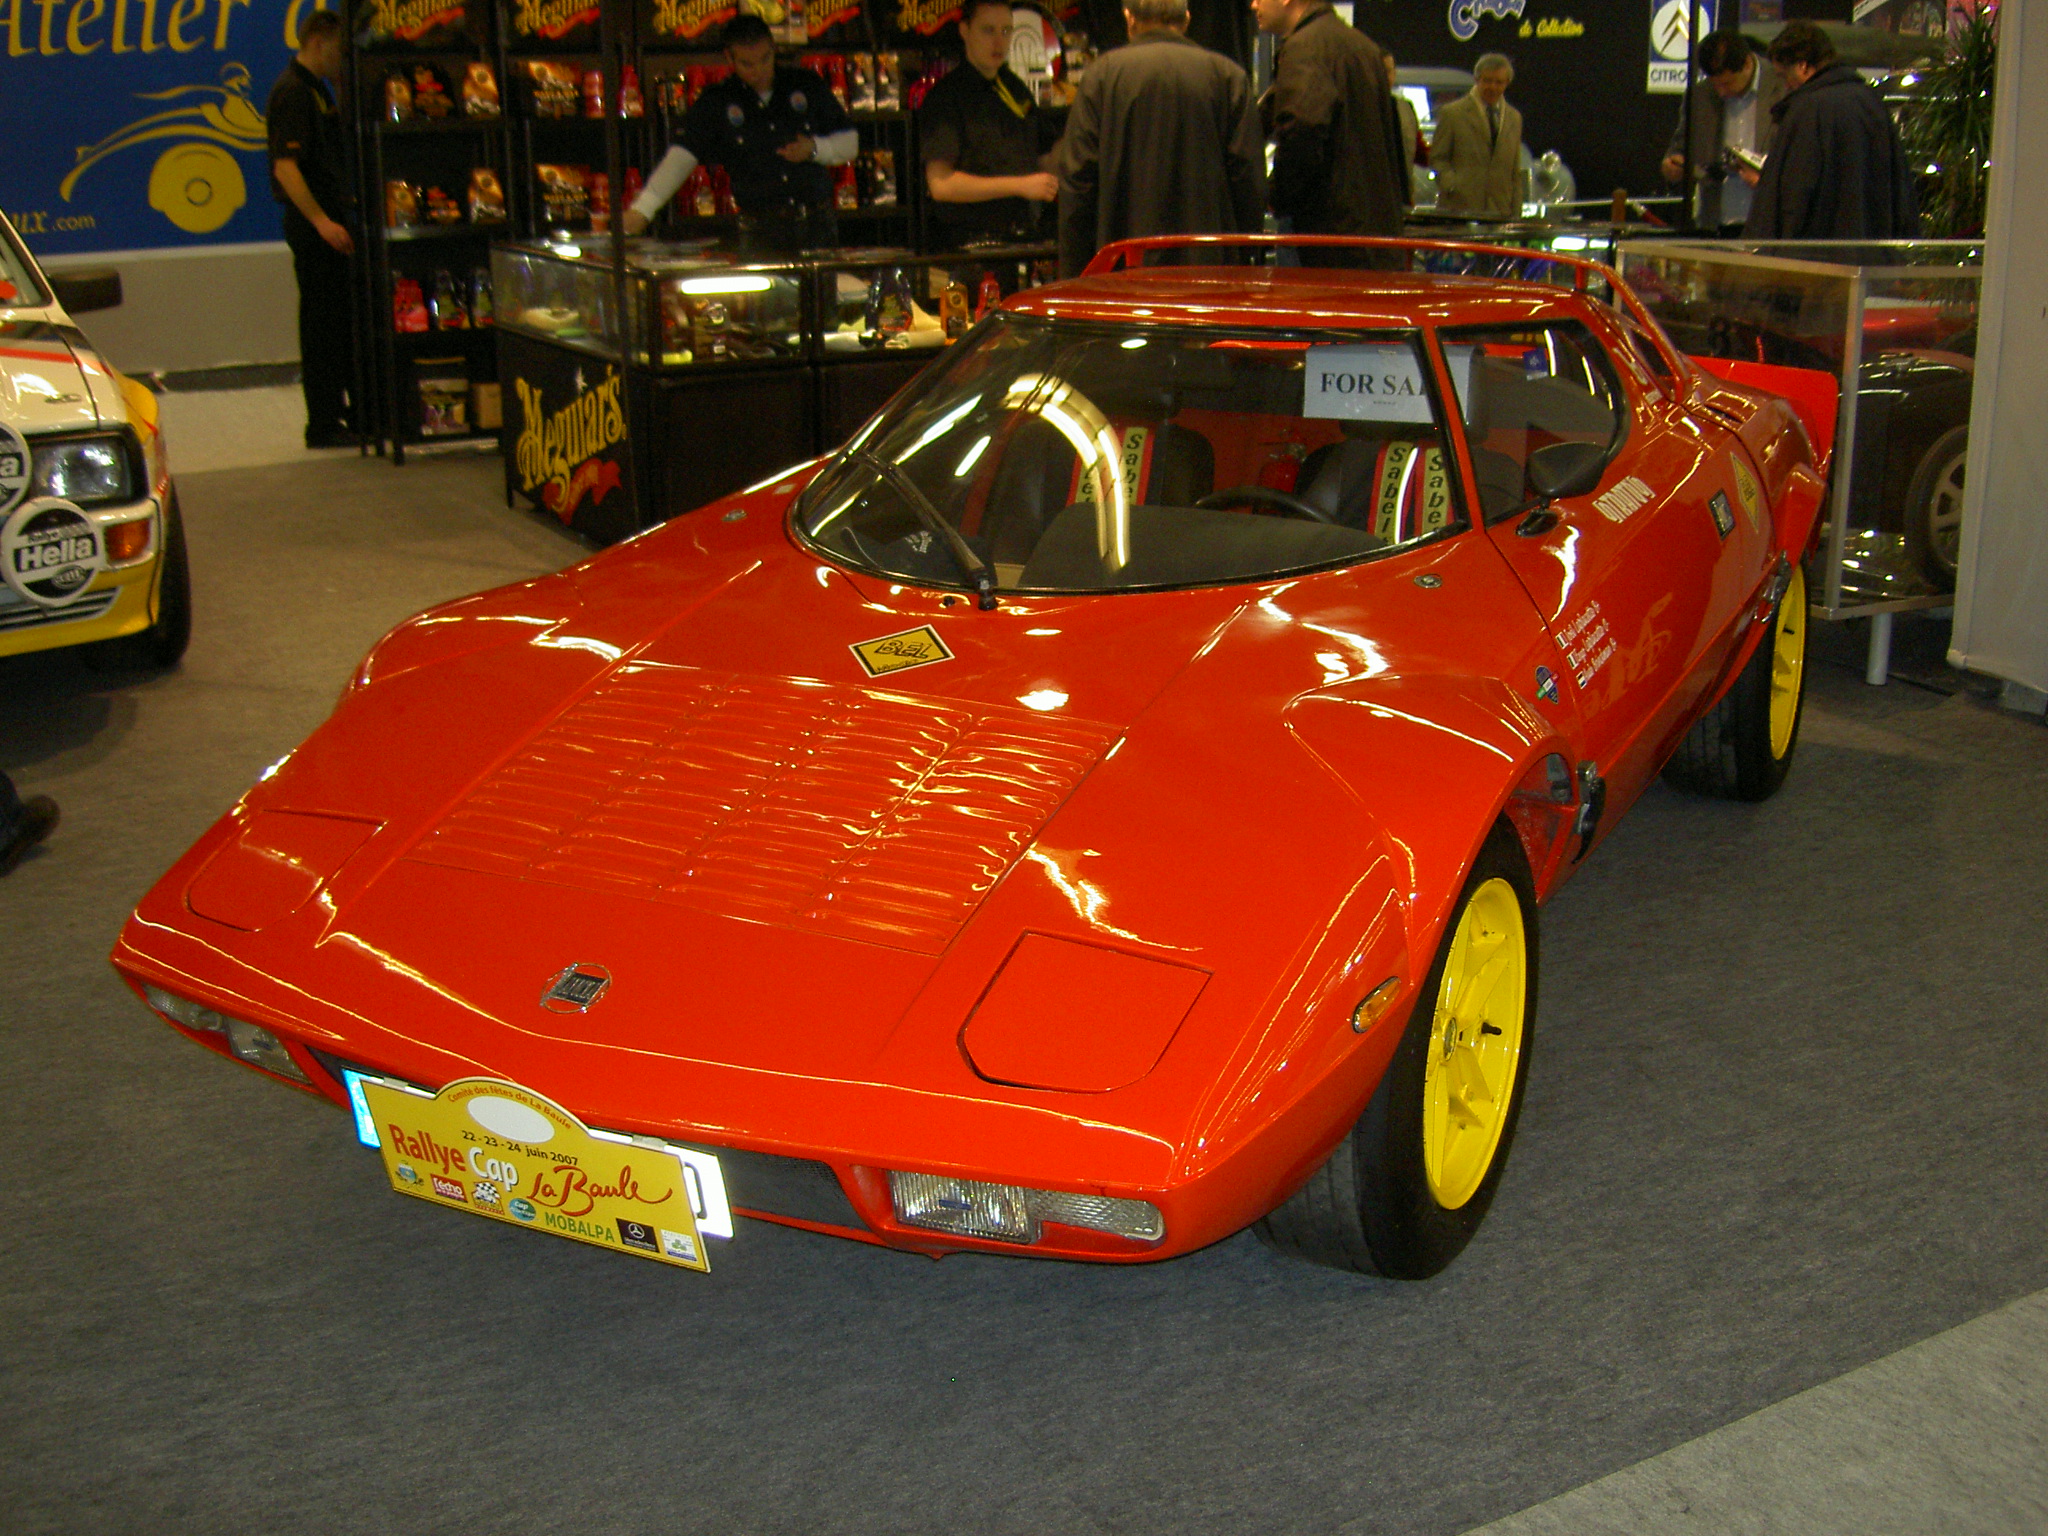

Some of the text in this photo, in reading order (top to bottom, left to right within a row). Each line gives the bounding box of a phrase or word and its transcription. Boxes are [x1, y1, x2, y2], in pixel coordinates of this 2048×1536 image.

[1650, 69, 1688, 83] CITRO
[1321, 372, 1428, 397] FOR SA
[20, 535, 94, 573] Hella
[448, 1085, 572, 1130] Comité des fêtes de La Baule
[388, 1123, 467, 1175] Rallye
[461, 1130, 579, 1166] 22 23 24 juin 2007
[469, 1146, 520, 1193] Cap
[526, 1171, 560, 1207] La
[554, 1164, 673, 1217] Baule
[544, 1211, 615, 1243] MOBALPA
